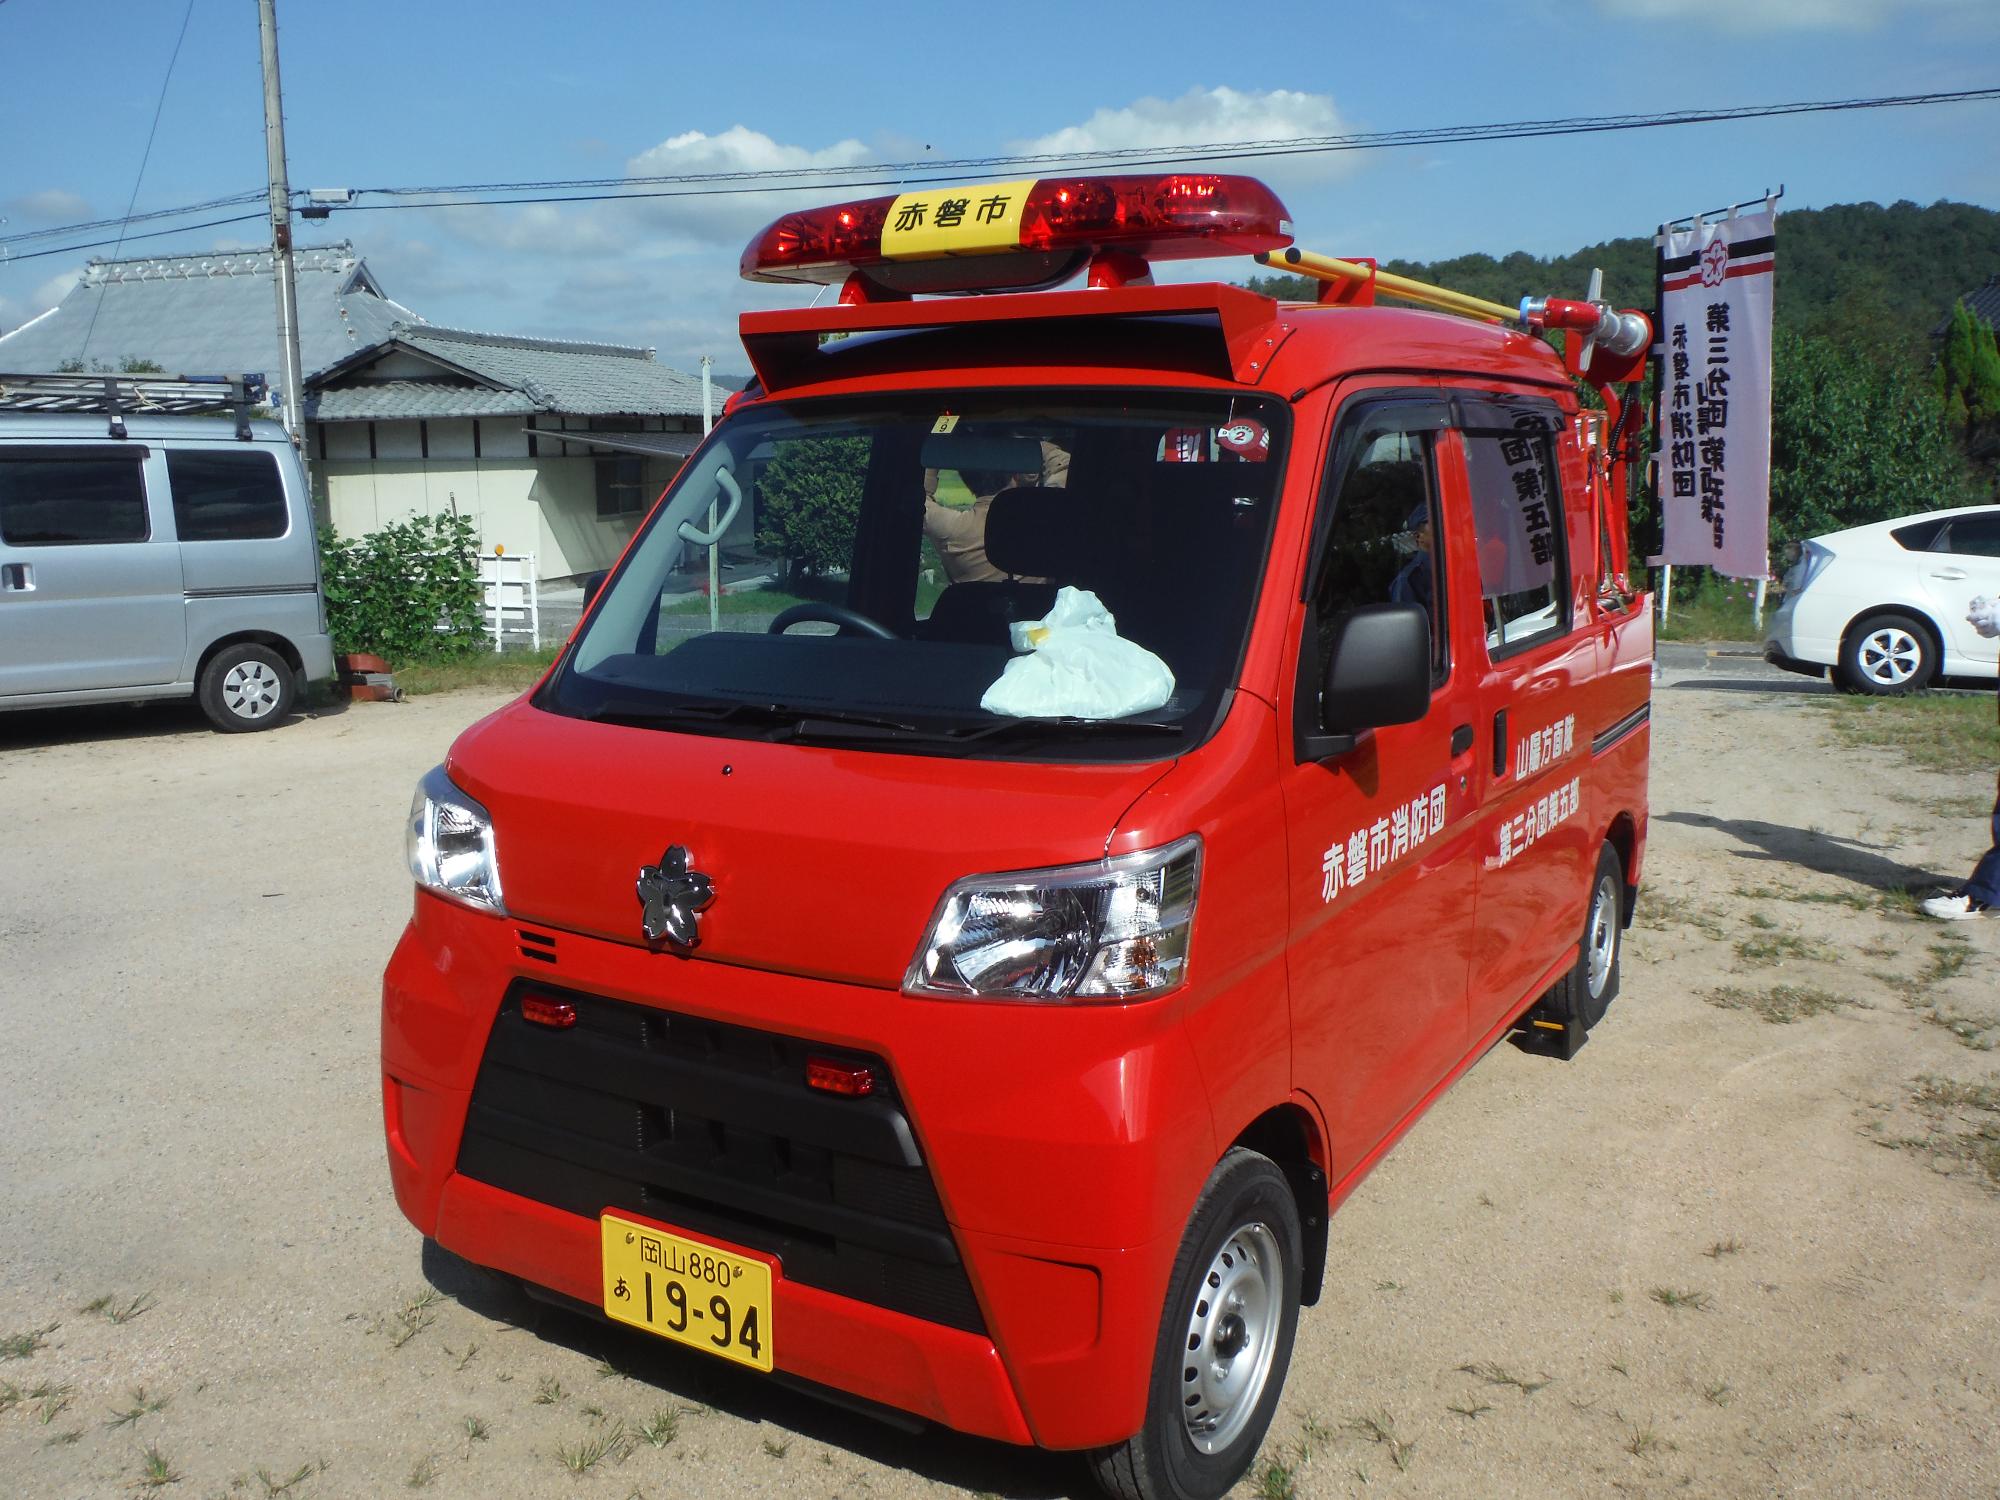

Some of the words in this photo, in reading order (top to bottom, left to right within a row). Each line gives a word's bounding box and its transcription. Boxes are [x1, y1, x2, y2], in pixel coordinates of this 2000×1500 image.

[894, 194, 1012, 232] 赤磐市
[1234, 431, 1246, 441] 2
[1322, 783, 1446, 903] 赤磐市消防団
[1498, 776, 1580, 868] 第三分団第五部
[613, 1275, 631, 1302] あ
[645, 1271, 761, 1359] 19-94
